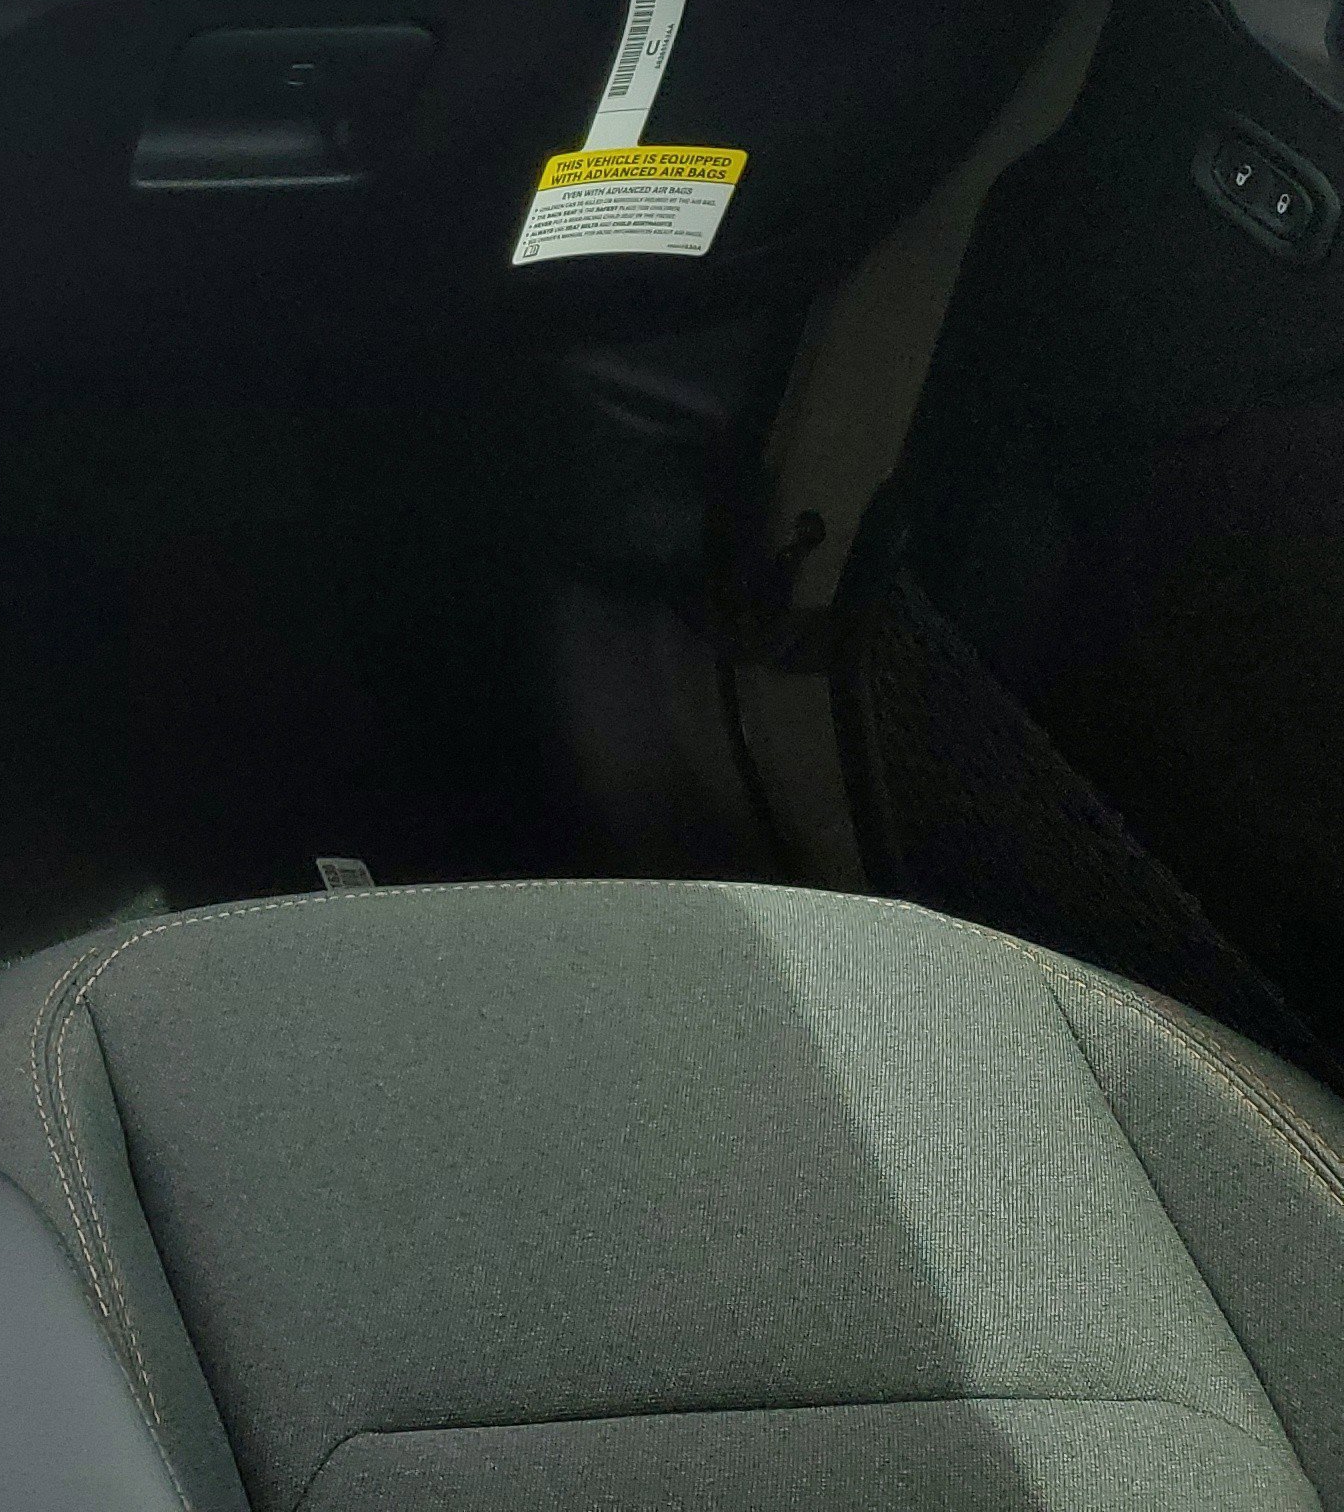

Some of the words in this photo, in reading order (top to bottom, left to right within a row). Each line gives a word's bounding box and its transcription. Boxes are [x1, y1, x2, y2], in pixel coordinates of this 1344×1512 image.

[556, 161, 583, 173] THIS
[586, 154, 642, 168] VEHICLE
[643, 154, 657, 165] IS
[659, 153, 732, 168] EQUIPPED
[551, 172, 583, 186] WITH
[584, 167, 658, 181] ADVANCED
[659, 167, 686, 178] AIR
[688, 167, 726, 180] BAGS
